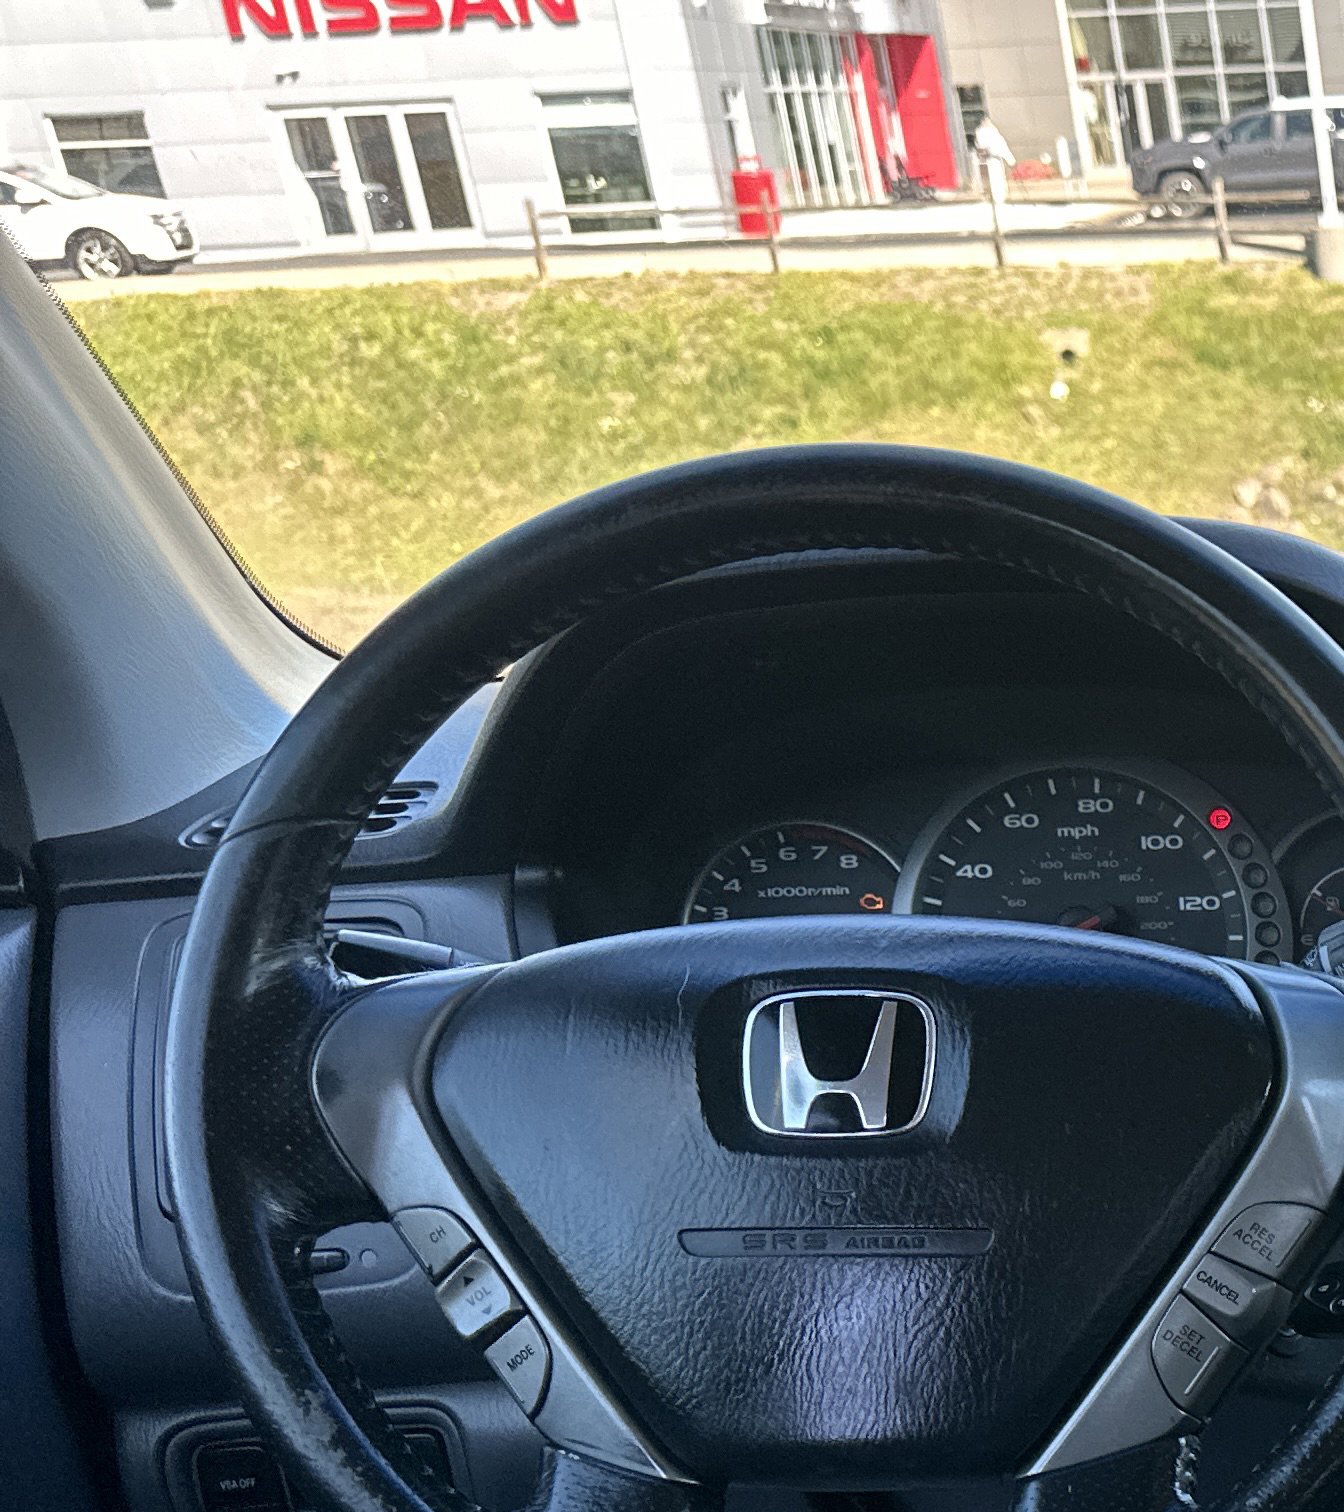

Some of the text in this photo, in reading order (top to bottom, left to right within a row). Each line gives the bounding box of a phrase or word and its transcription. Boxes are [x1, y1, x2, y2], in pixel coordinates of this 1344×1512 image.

[1077, 798, 1114, 814] 80
[1003, 813, 1040, 829] 60
[1057, 824, 1100, 840] mph
[1140, 834, 1184, 851] 100
[778, 846, 798, 862] 6
[810, 845, 829, 861] 7
[750, 858, 768, 873] 5
[839, 854, 859, 869] 8
[955, 863, 993, 879] 40
[1063, 871, 1101, 881] km/h
[723, 878, 742, 893] 4
[1177, 896, 1221, 911] 120
[713, 906, 730, 921] 3
[429, 1224, 447, 1244] CH
[741, 1232, 829, 1251] SRS
[1250, 1222, 1276, 1245] RES
[1233, 1228, 1273, 1262] ACCEL
[1196, 1270, 1239, 1305] CANCEL
[465, 1286, 492, 1307] VOL
[1179, 1324, 1205, 1345] SET
[1162, 1329, 1202, 1362] DECEL
[506, 1344, 535, 1372] MODE
